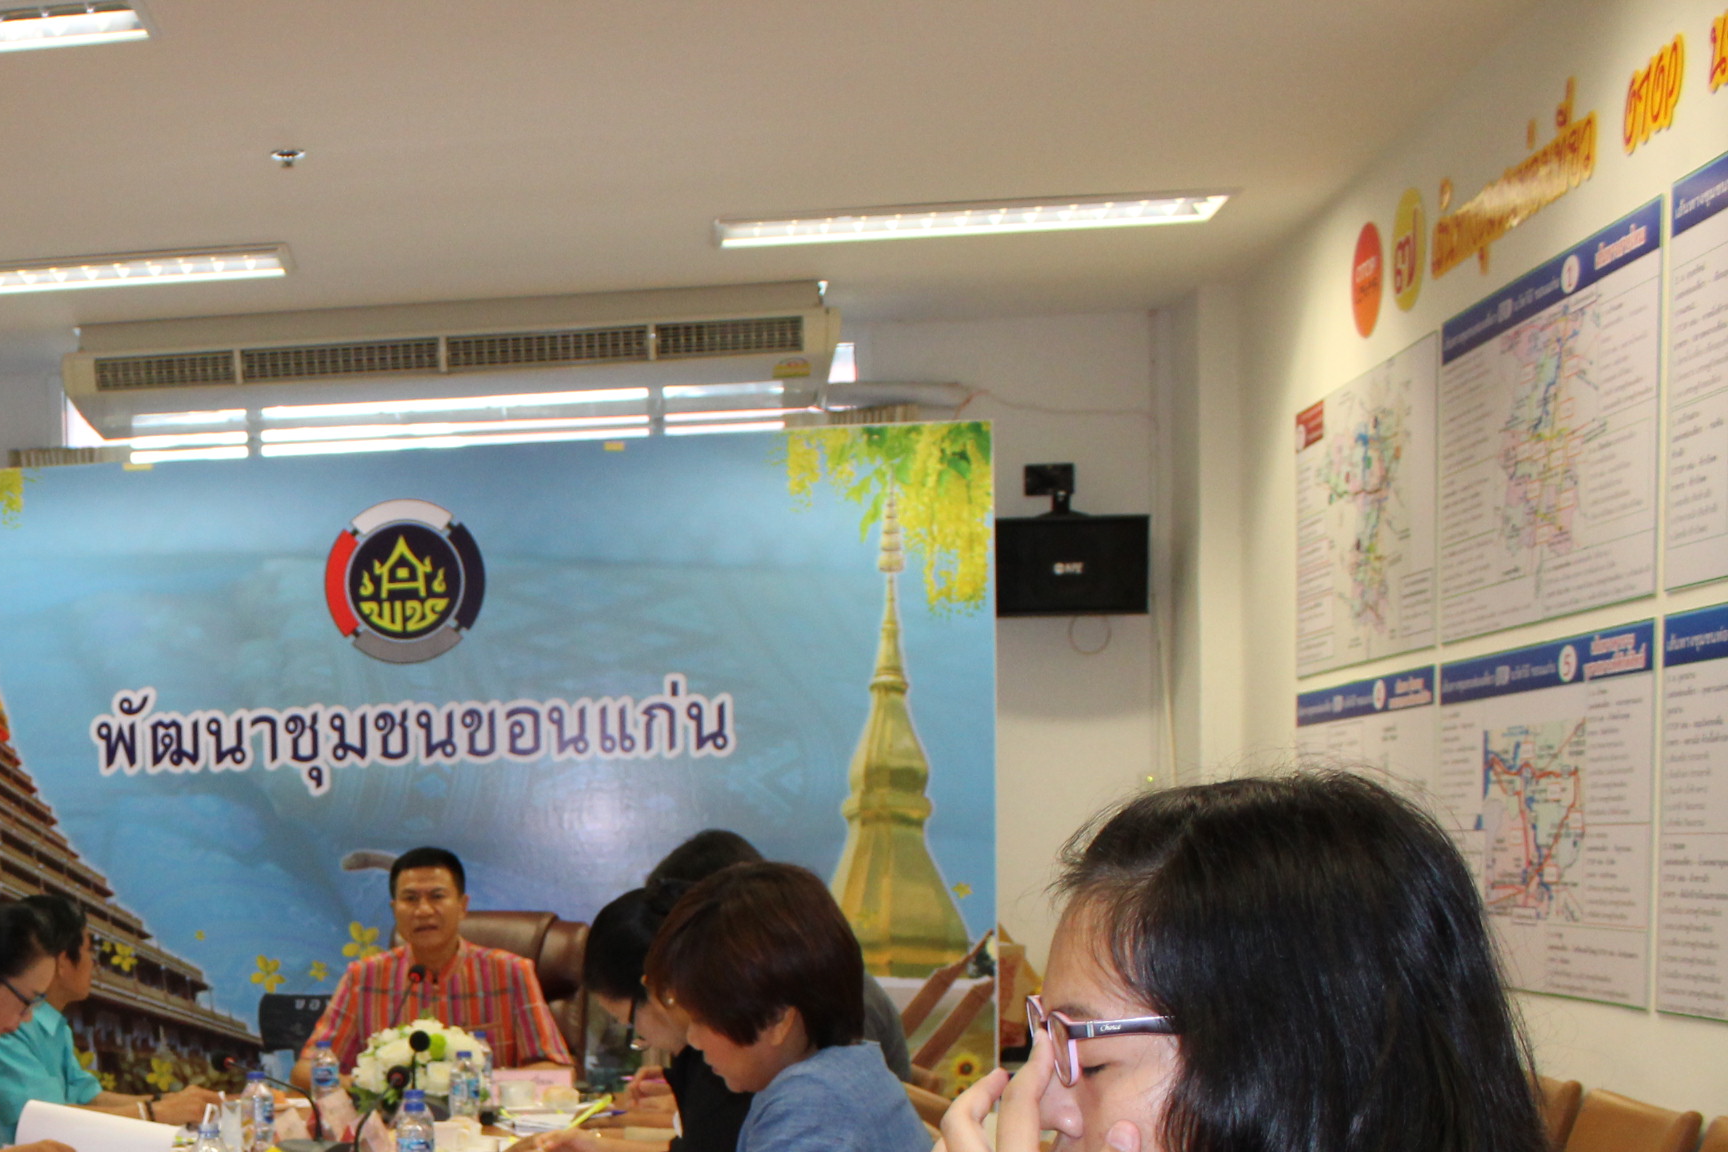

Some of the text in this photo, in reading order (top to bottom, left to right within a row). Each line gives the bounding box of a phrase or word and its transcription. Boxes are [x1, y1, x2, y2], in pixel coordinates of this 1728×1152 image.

[95, 678, 731, 791] พัฒนาชุมชนขอนแก่น
